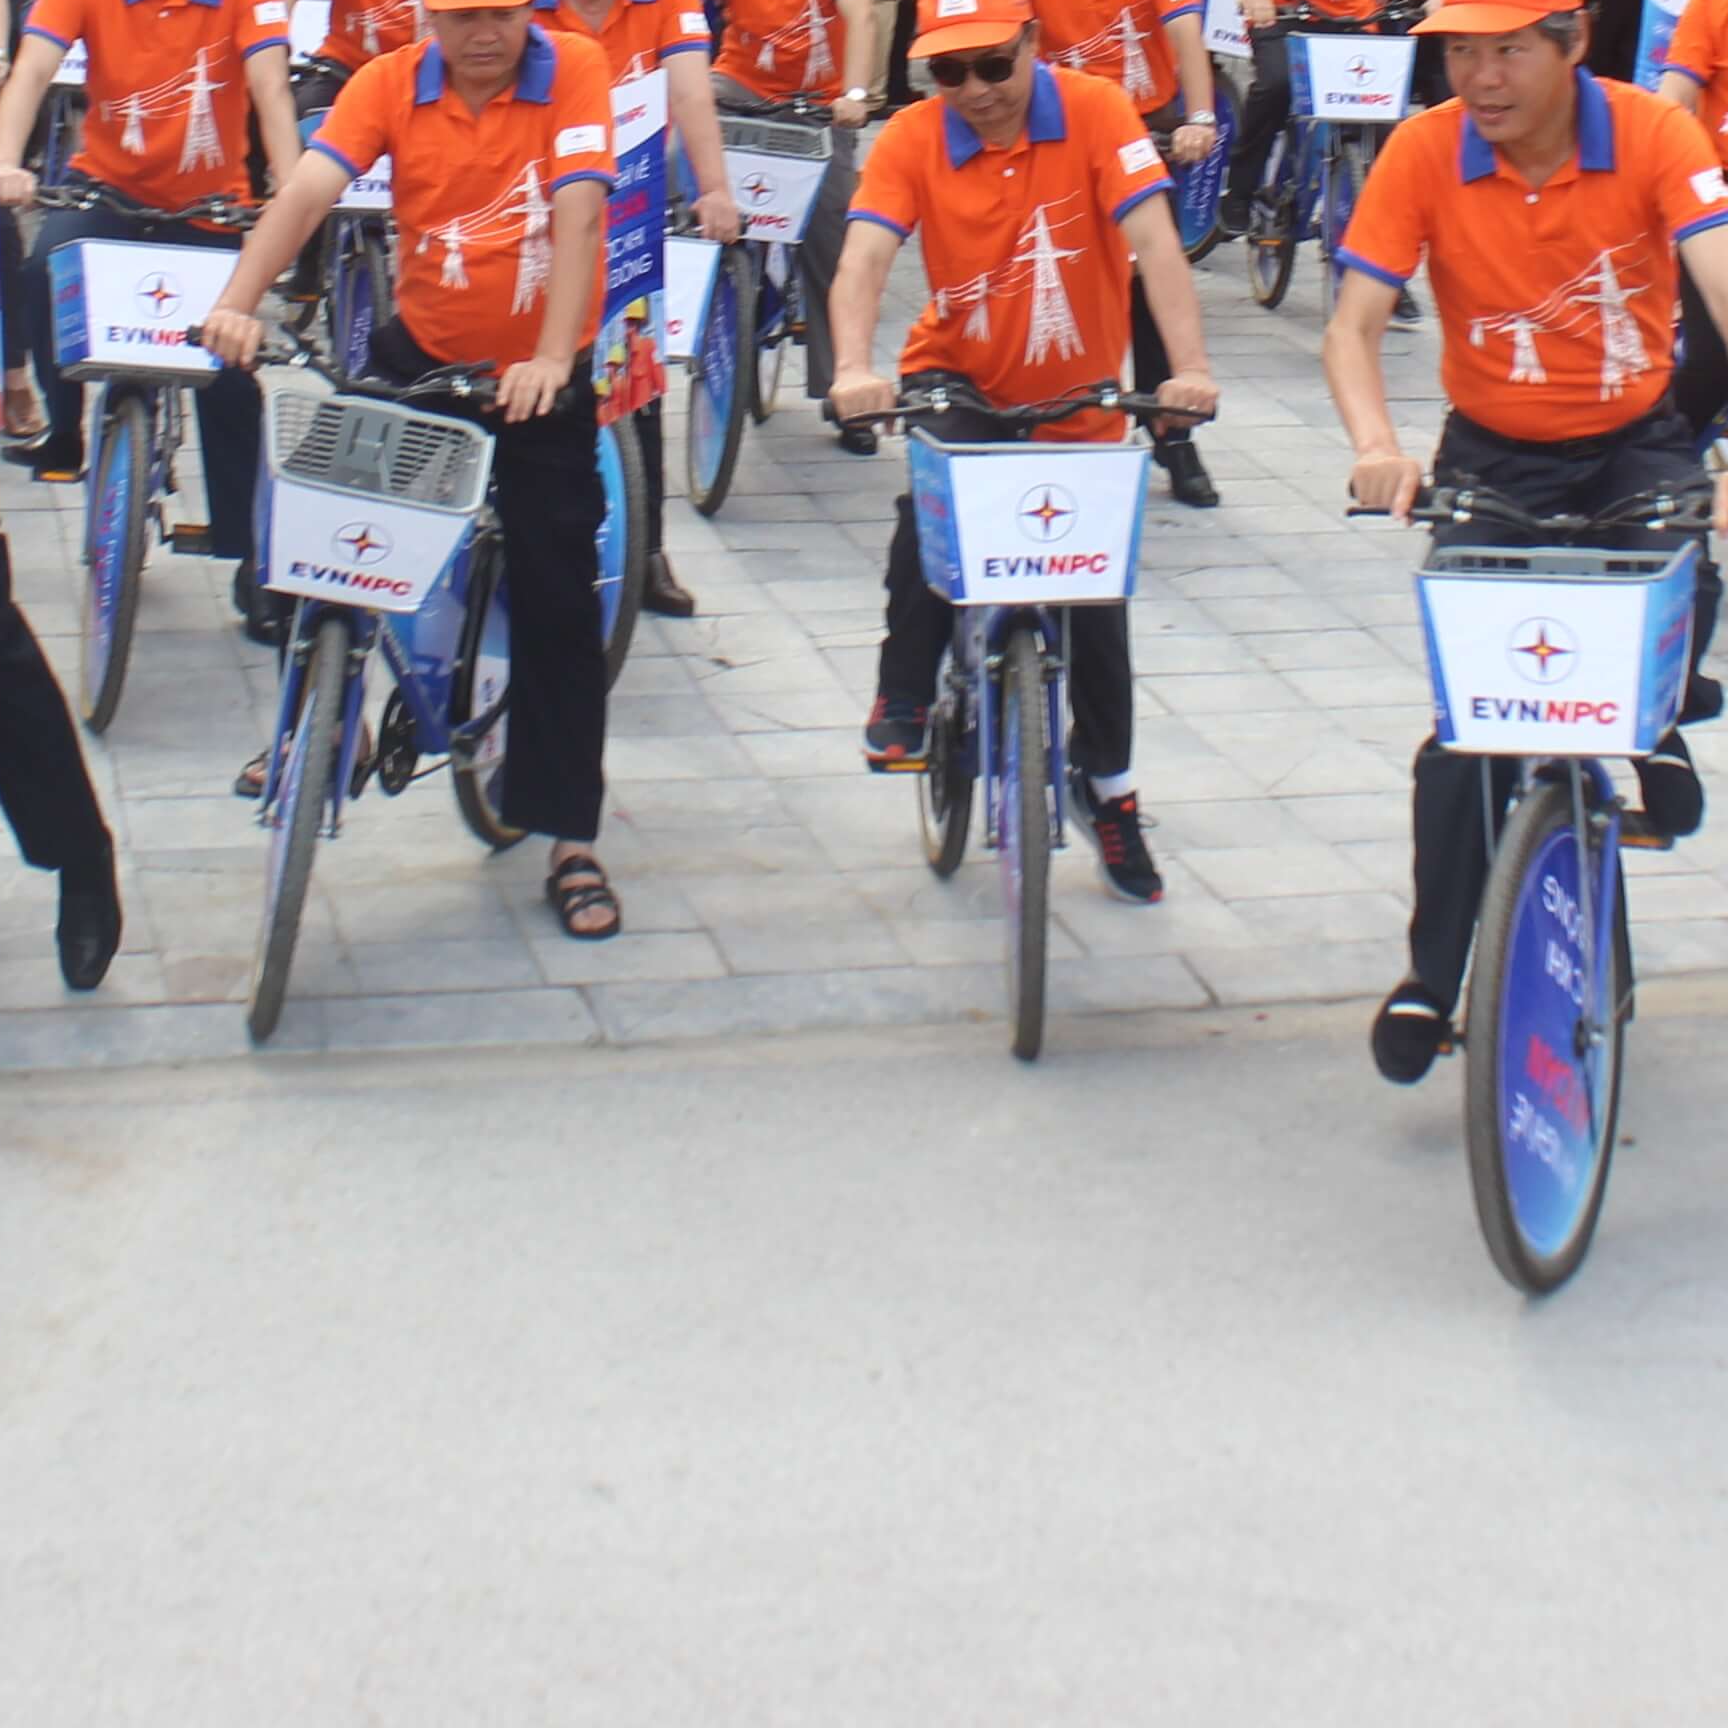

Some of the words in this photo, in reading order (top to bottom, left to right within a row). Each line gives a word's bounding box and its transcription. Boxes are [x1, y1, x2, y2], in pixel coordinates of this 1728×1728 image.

[289, 560, 412, 598] EVNNPC
[983, 552, 1110, 579] EVNNPC
[1469, 696, 1620, 727] EVNNPC
